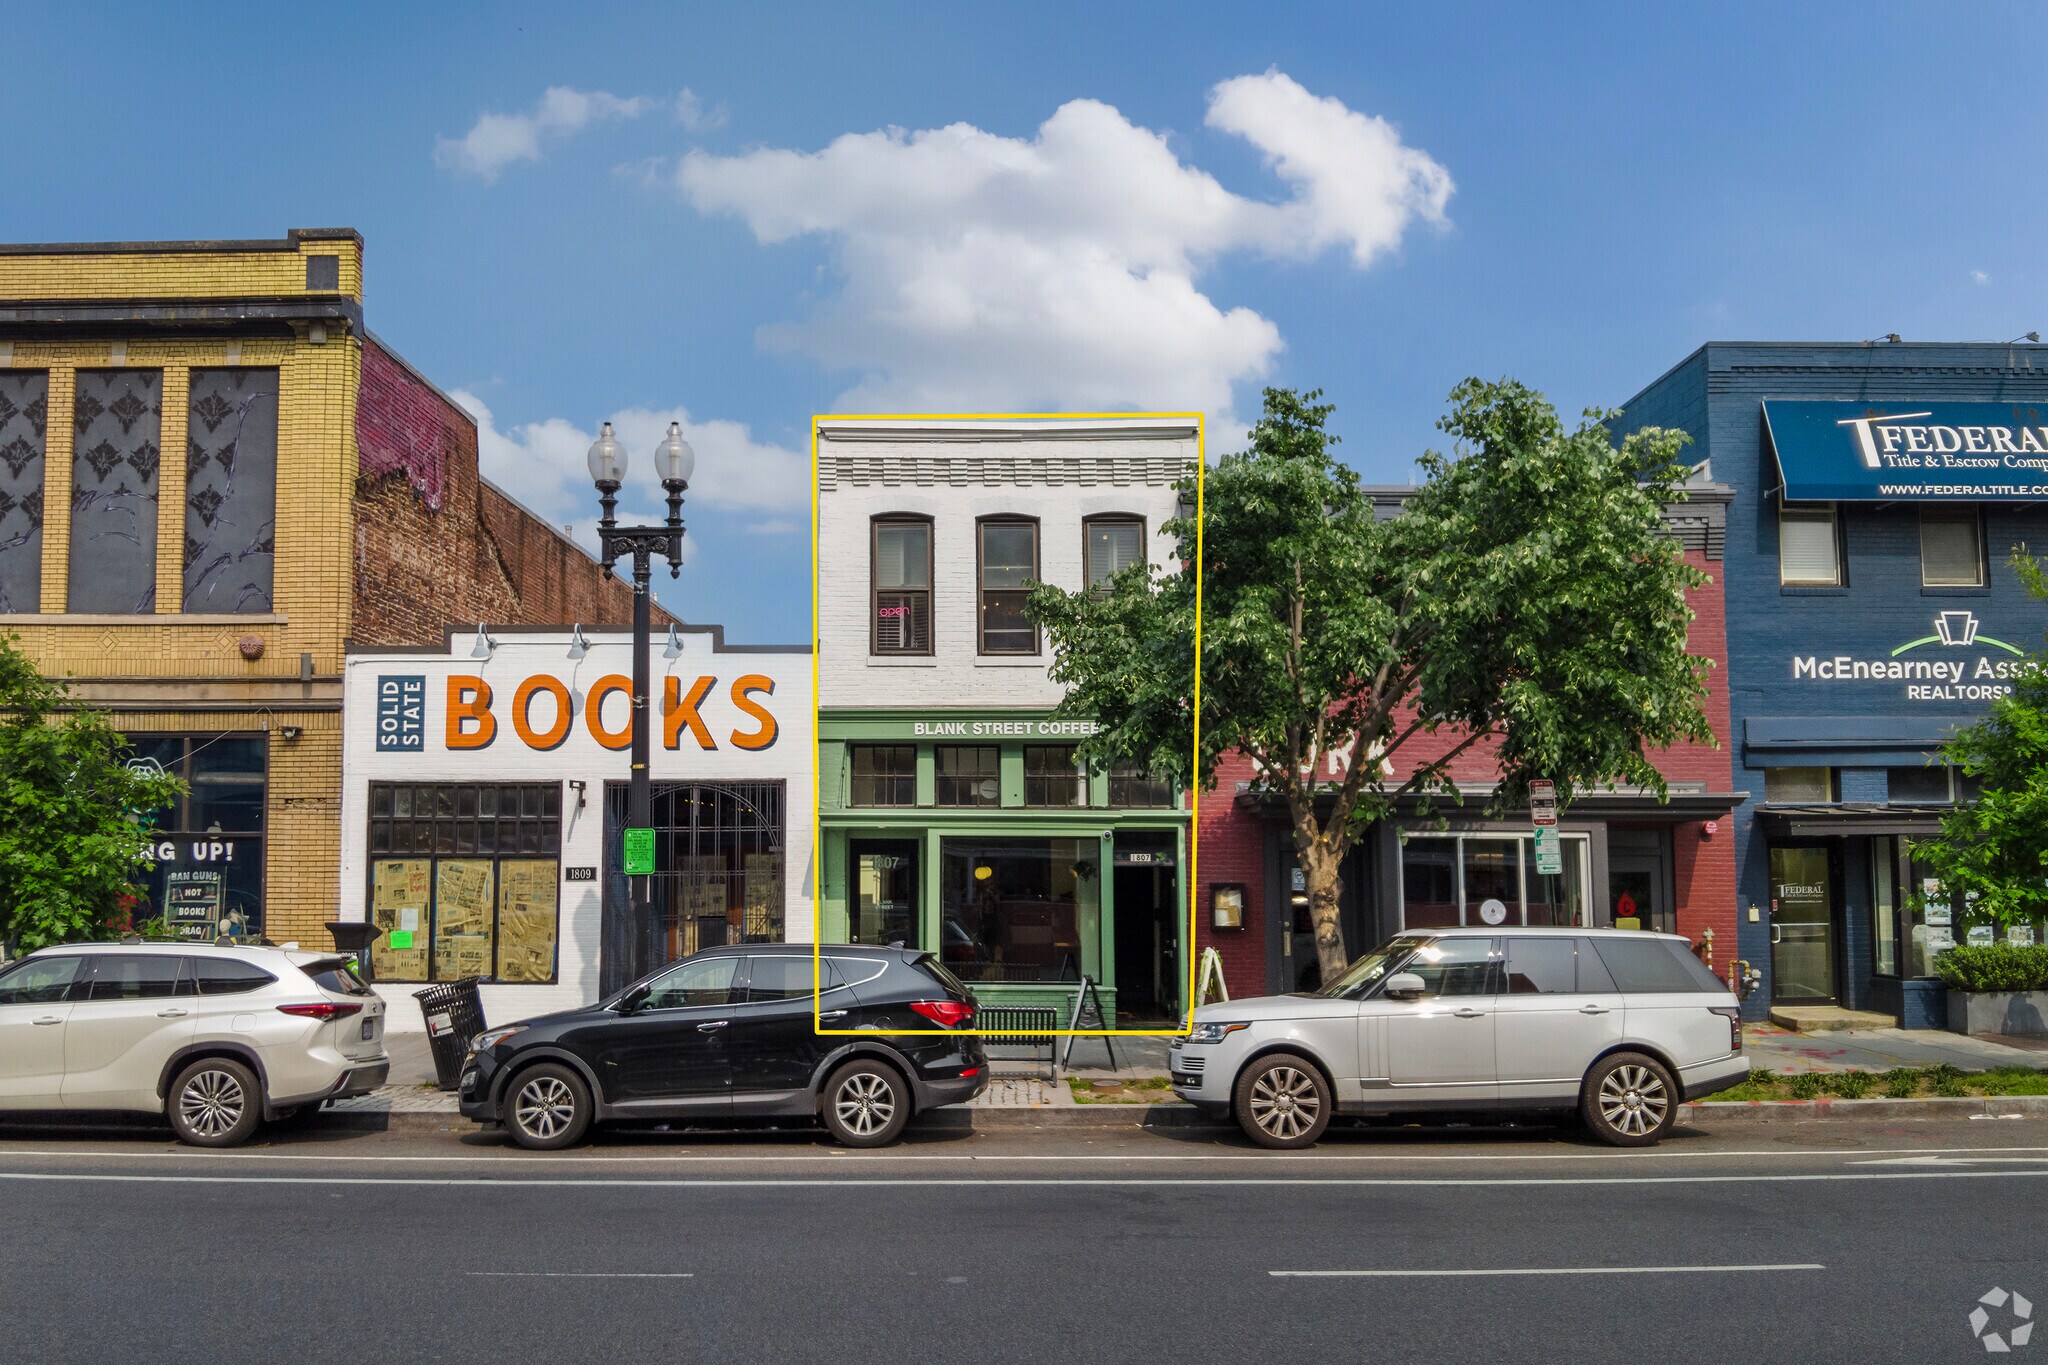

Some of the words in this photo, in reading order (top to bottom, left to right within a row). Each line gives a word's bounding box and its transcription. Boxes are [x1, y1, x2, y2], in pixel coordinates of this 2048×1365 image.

[1883, 454, 1921, 468] Title
[1925, 455, 1939, 468] &
[1943, 454, 1999, 468] Escrow
[880, 606, 910, 618] open
[1794, 656, 1965, 683] McEnearney
[1974, 657, 2048, 679] Asso
[381, 681, 400, 746] SOLID
[402, 681, 421, 746] STATE
[445, 674, 780, 752] BOOKS
[914, 722, 967, 735] BLANK
[972, 722, 1033, 735] STREET
[1038, 722, 1100, 735] COFFEE
[193, 842, 233, 861] UP!
[171, 872, 190, 880] BAN
[192, 871, 218, 880] GUNS
[571, 868, 591, 880] 1809
[185, 888, 202, 896] NOT
[178, 907, 206, 916] BOOKS
